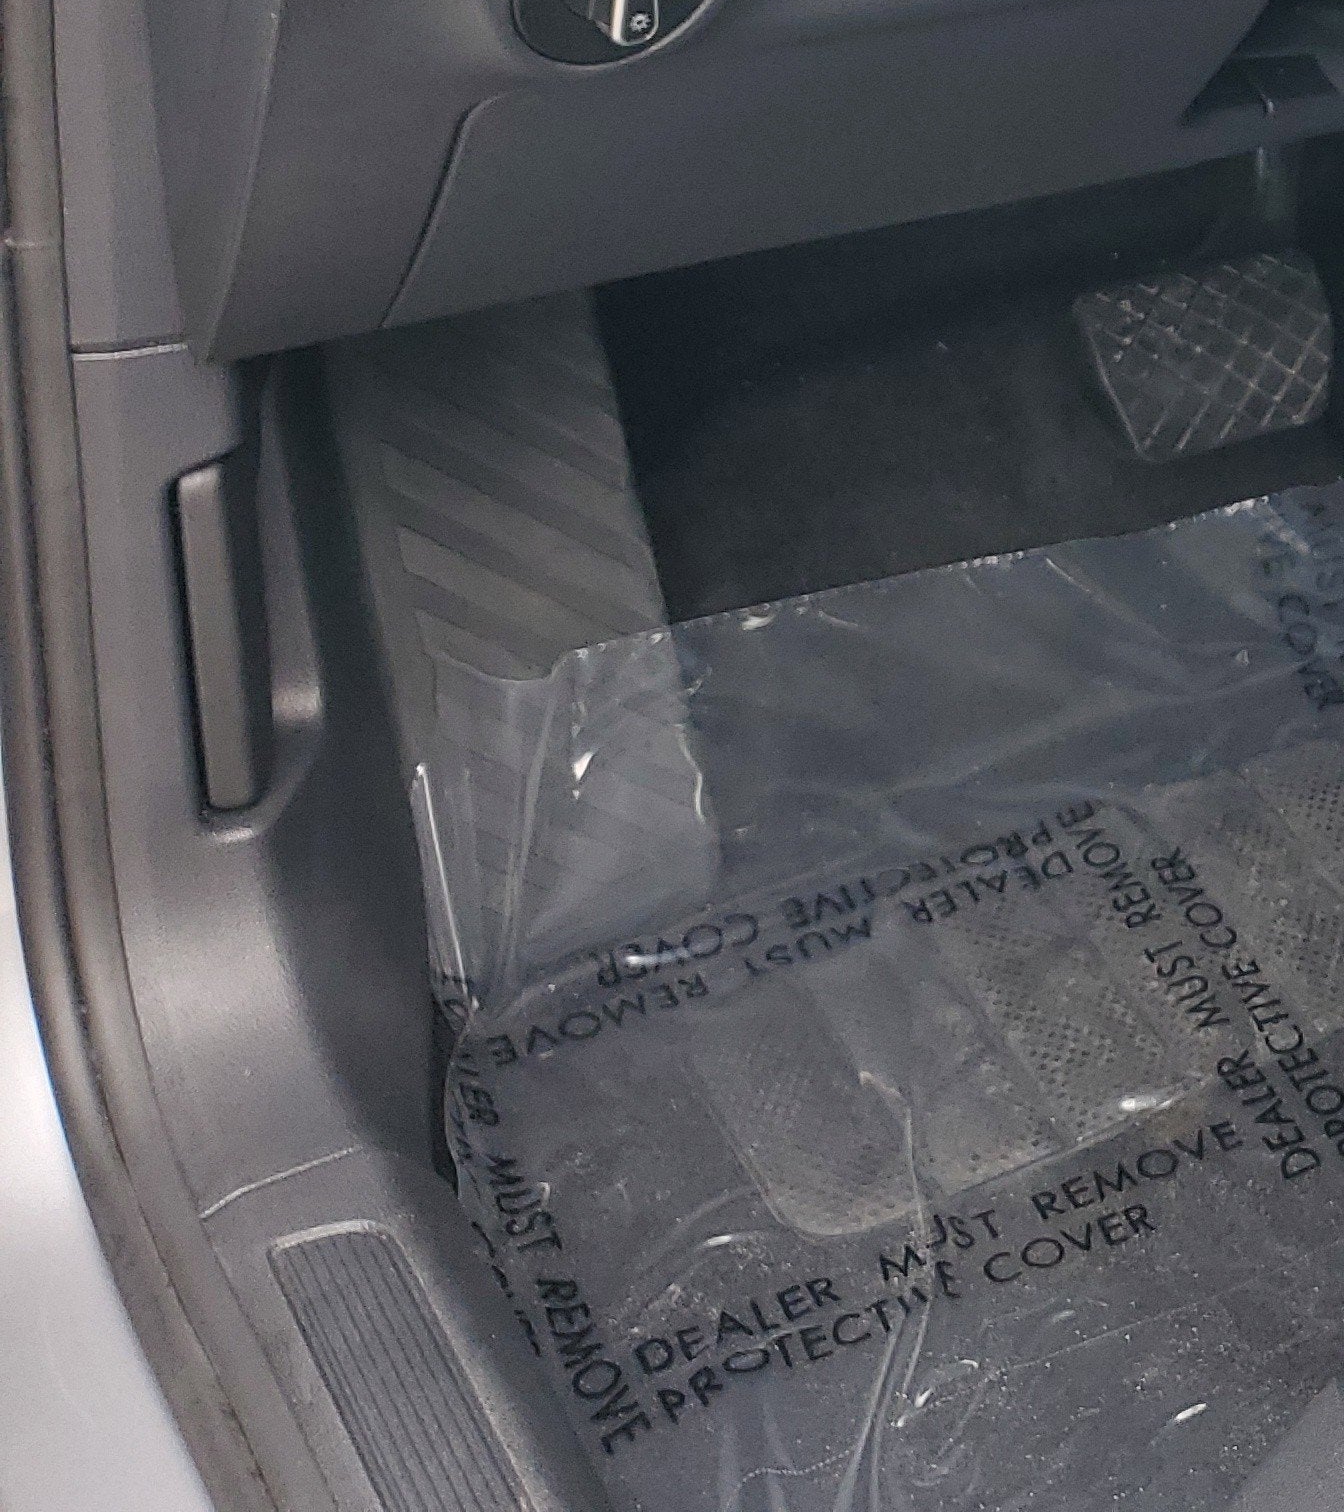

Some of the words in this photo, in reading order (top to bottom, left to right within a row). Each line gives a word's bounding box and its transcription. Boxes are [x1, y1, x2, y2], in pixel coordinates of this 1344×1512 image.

[904, 850, 1073, 925] DEALER
[1056, 799, 1163, 929] REMOVE
[1151, 845, 1238, 950] COVER
[745, 918, 872, 979] MUST
[1143, 940, 1230, 1031] MUST
[487, 974, 709, 1066] REMOVE
[1216, 1049, 1321, 1181] DEALER
[634, 1276, 840, 1374] DEALER
[1031, 1120, 1244, 1221] REMOVE
[983, 1203, 1158, 1284] COVER
[487, 1153, 562, 1254] MUST
[534, 1279, 651, 1455] REMOVE
